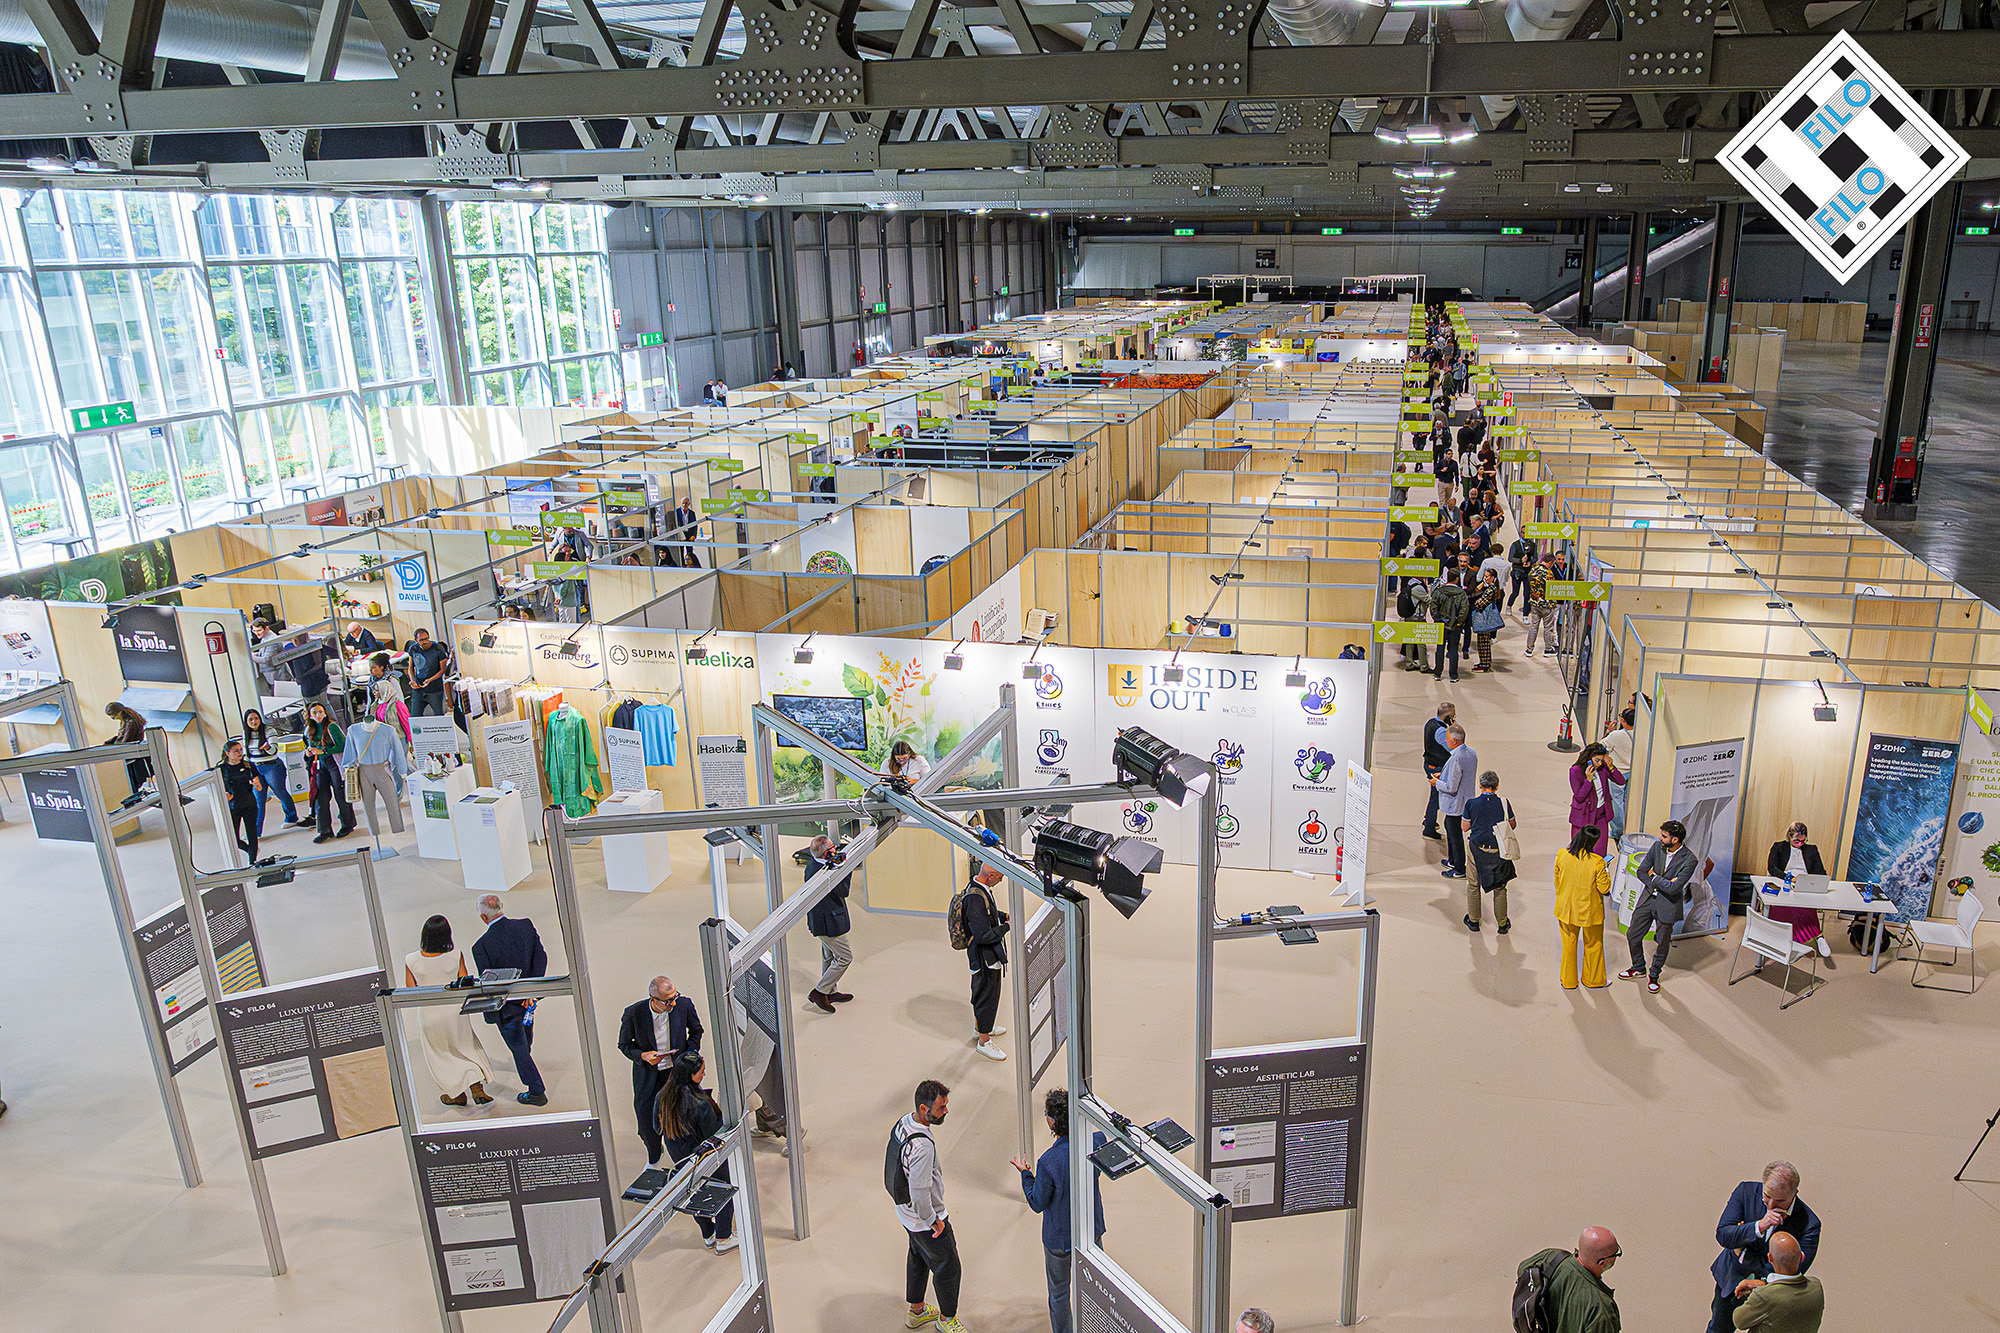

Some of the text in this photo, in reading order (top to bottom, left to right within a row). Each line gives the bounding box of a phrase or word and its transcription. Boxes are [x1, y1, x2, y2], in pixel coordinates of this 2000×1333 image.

[398, 592, 429, 602] DAVIFIL
[118, 633, 132, 649] la
[631, 648, 676, 660] SUPIMA
[1149, 665, 1258, 690] ISIDE
[1149, 688, 1211, 712] OUT
[493, 734, 525, 744] Bemberg
[618, 737, 641, 746] SUPIMA
[1689, 754, 1707, 763] ZDHC
[1962, 774, 1985, 782] TUTTA
[30, 792, 46, 806] la
[1298, 846, 1328, 854] HEALTH
[1627, 889, 1637, 912] PAPER
[155, 925, 167, 936] FILO
[247, 1003, 266, 1013] FILO
[278, 1001, 335, 1018] LUXURY LAB
[1232, 1066, 1250, 1074] FILO
[1256, 1070, 1315, 1083] AESTHETIC LAB
[445, 1141, 477, 1150] FILO 64
[479, 1147, 541, 1160] LUXURY LAB
[1095, 1280, 1109, 1297] FILO
